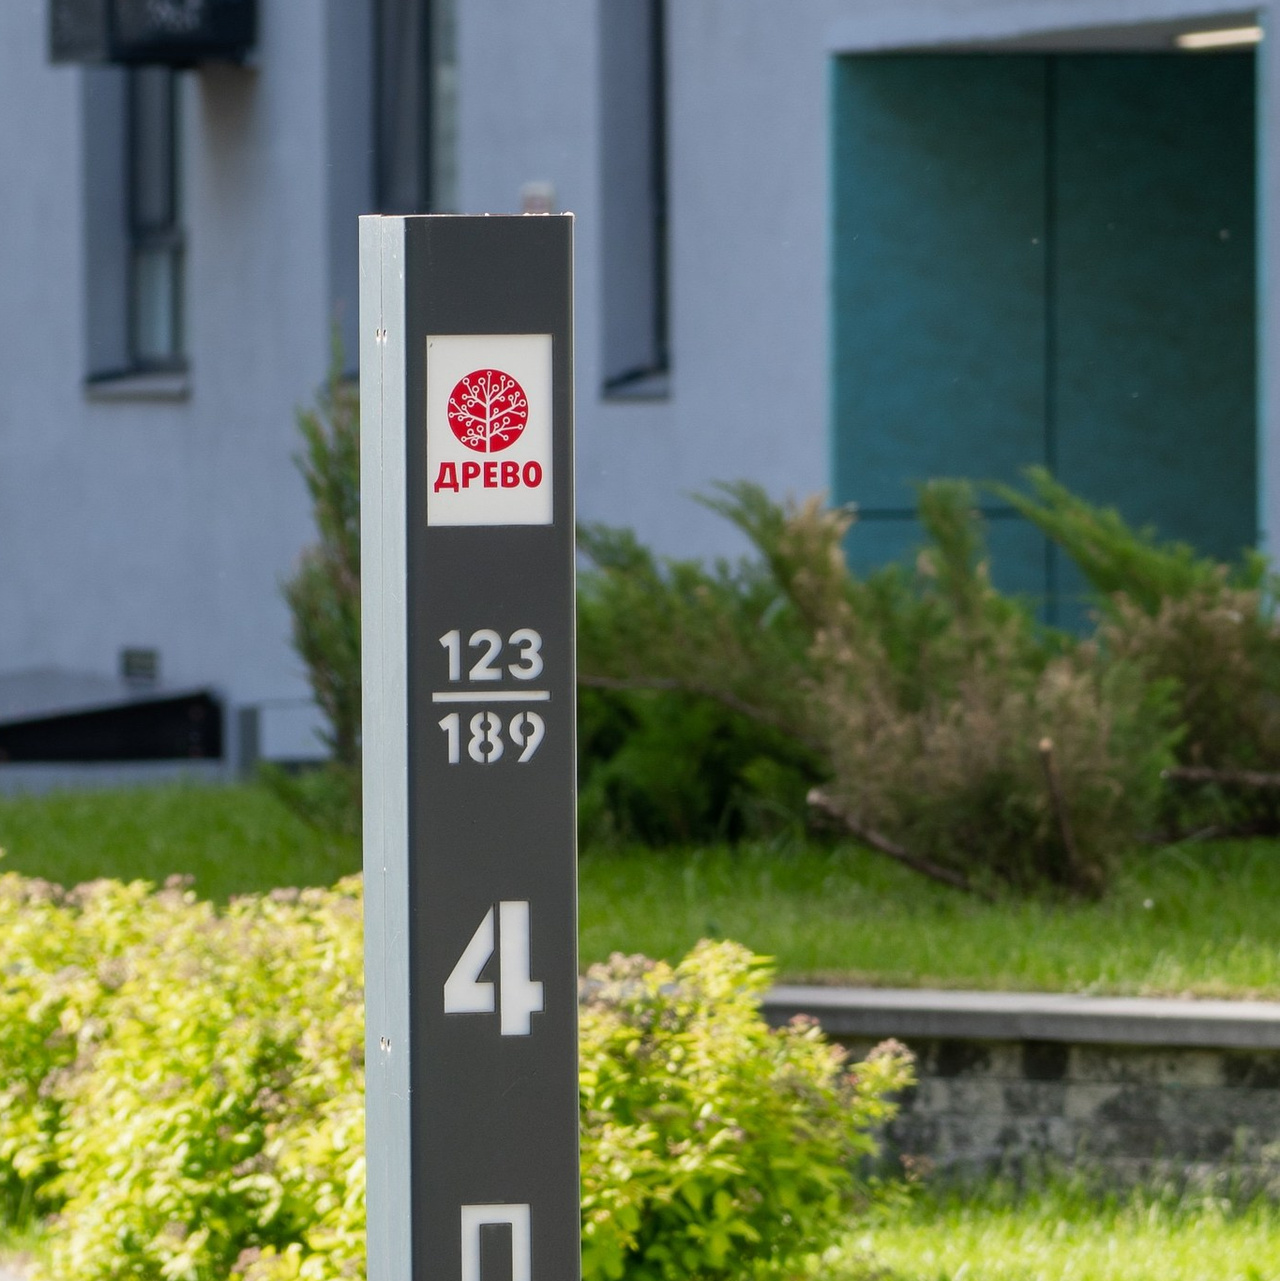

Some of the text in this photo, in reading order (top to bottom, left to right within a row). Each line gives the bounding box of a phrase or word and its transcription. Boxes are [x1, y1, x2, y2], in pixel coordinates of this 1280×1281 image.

[433, 460, 543, 493] ДРЕВО
[438, 628, 544, 681] 123
[438, 711, 545, 764] 189
[443, 900, 544, 1037] 4
